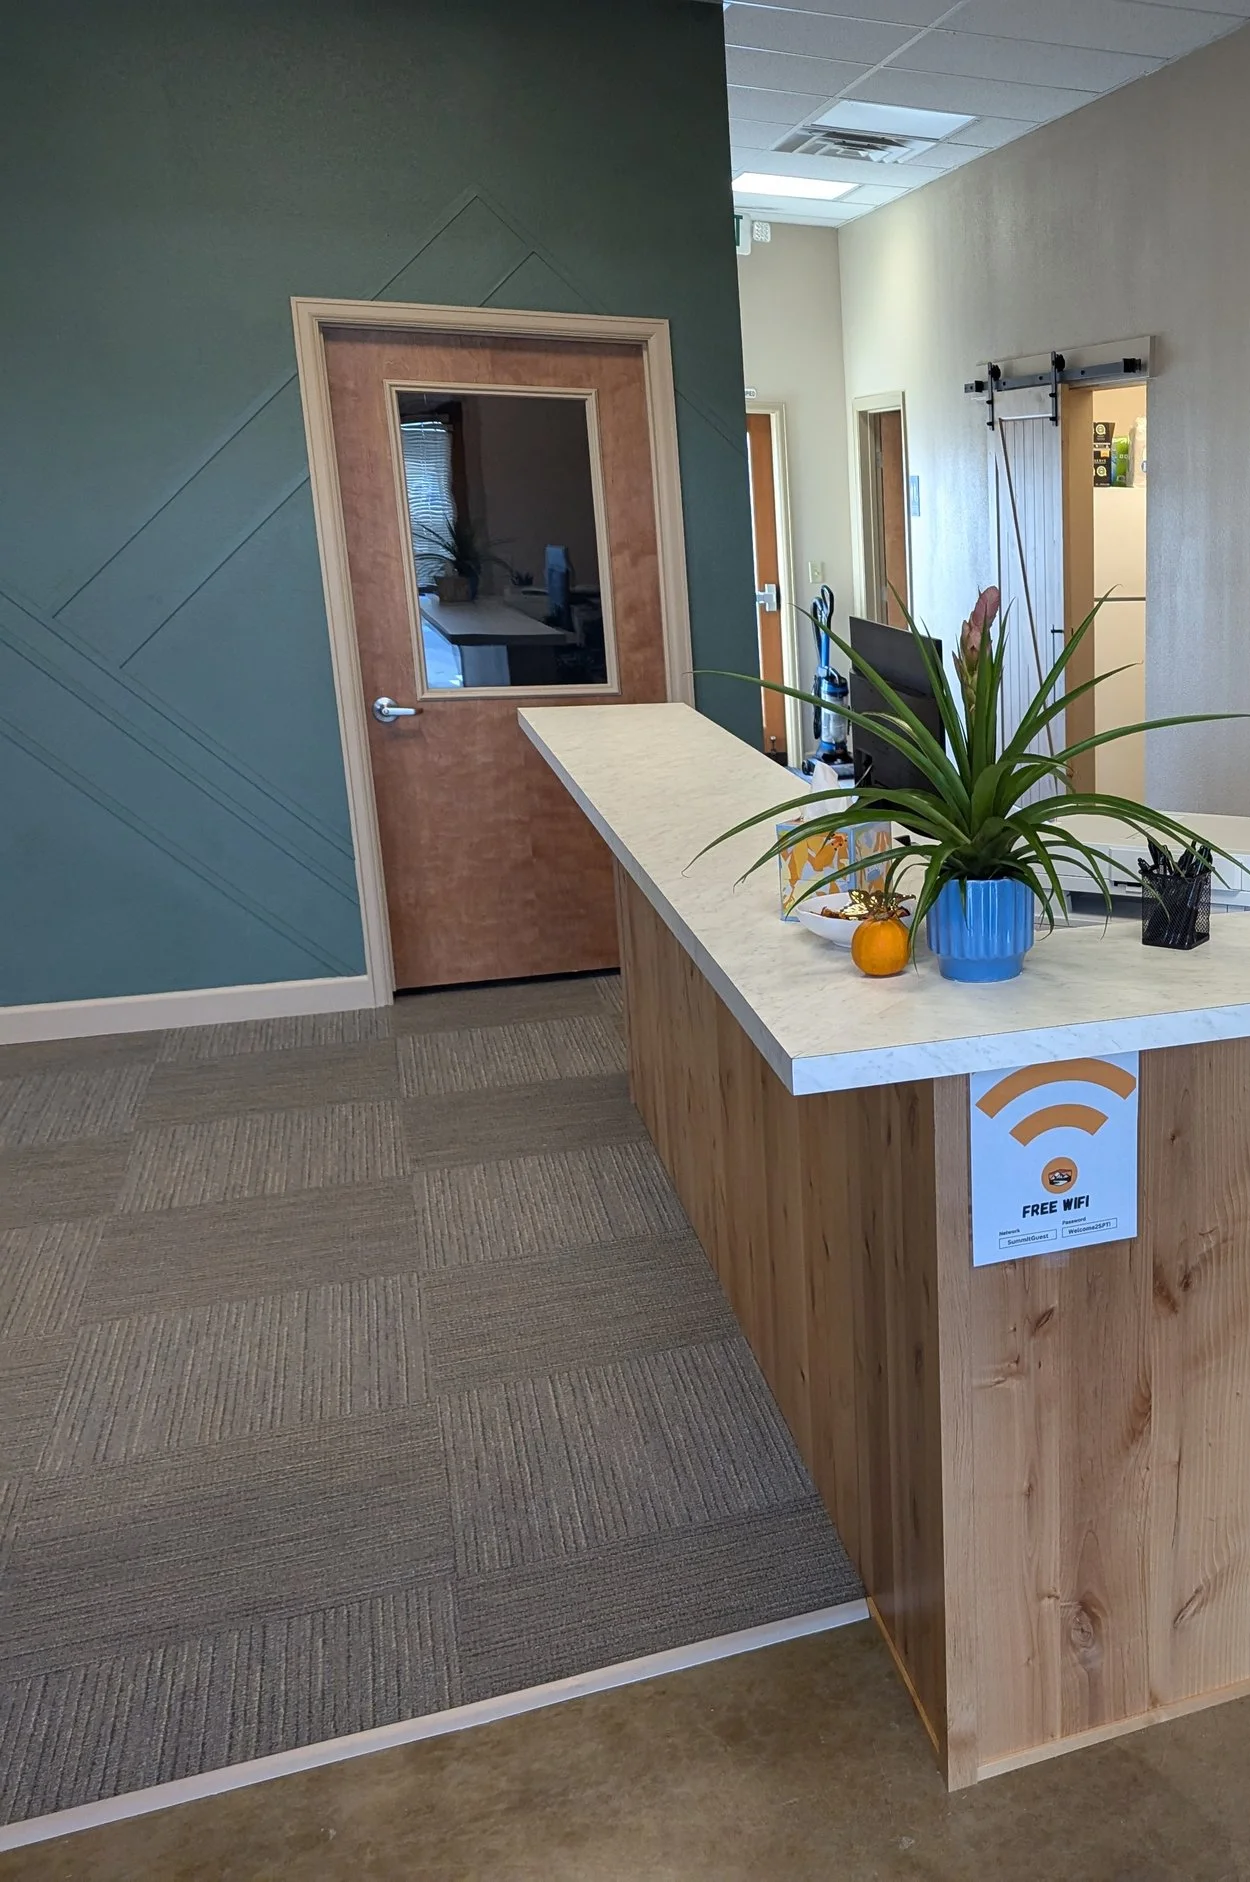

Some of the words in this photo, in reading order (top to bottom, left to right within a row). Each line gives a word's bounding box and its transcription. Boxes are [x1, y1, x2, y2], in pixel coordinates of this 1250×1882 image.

[1022, 1200, 1058, 1218] FREE
[1063, 1195, 1090, 1212] WIFI
[999, 1228, 1020, 1236] Network
[1008, 1234, 1048, 1245] SummitGuest
